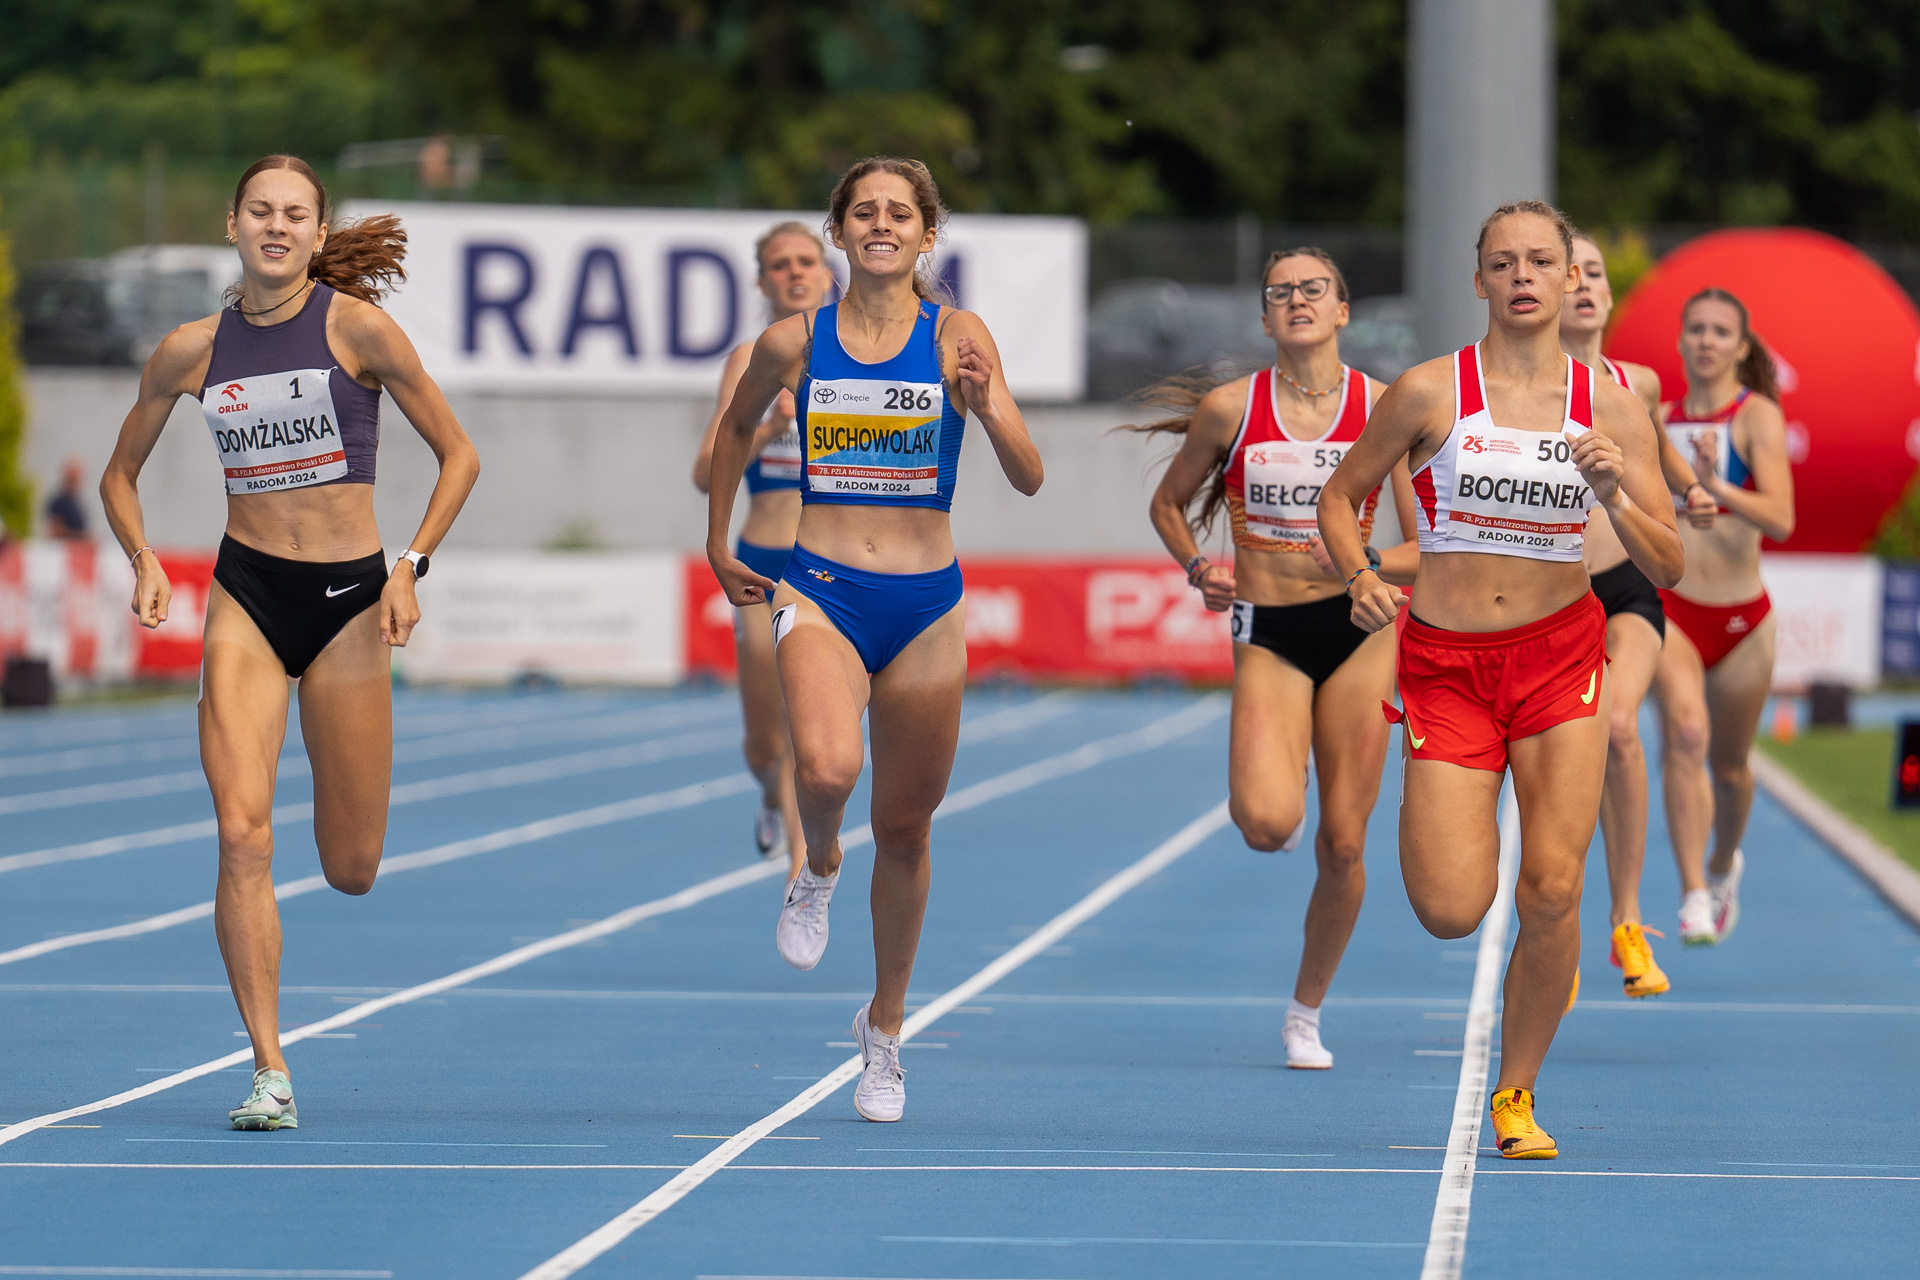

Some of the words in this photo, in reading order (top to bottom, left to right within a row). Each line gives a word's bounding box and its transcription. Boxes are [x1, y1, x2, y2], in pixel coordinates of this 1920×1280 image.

[462, 243, 966, 361] RAD
[289, 377, 303, 399] 1
[842, 393, 870, 402] Okęcie
[218, 402, 249, 414] ORLEN
[883, 387, 932, 411] 286
[215, 414, 336, 454] DOMŻALSKA
[813, 425, 935, 455] SUCHOWOLAK
[239, 469, 253, 477] PZLA
[253, 463, 296, 475] Mistrzostwa
[296, 458, 318, 469] Polski
[318, 454, 334, 464] U20
[1314, 448, 1347, 468] 53
[246, 476, 287, 490] RADOM
[289, 471, 318, 484] 2024
[819, 467, 830, 475] 78.
[831, 468, 847, 476] PZLA
[848, 469, 892, 478] Mistrzostwa
[893, 471, 915, 479] Polski
[915, 470, 928, 478] U20
[835, 480, 879, 491] RADOM
[881, 482, 911, 492] 2024
[1458, 473, 1590, 510] BOCHENEK
[1271, 527, 1310, 539] RADOM
[1462, 513, 1474, 523] 78.
[1474, 517, 1492, 526] PZLA
[1493, 520, 1539, 531] Mistrzostwa
[1540, 525, 1559, 533] Polski
[1478, 531, 1525, 544] RADOM
[1527, 536, 1555, 547] 2024
[1087, 571, 1232, 646] PZ
